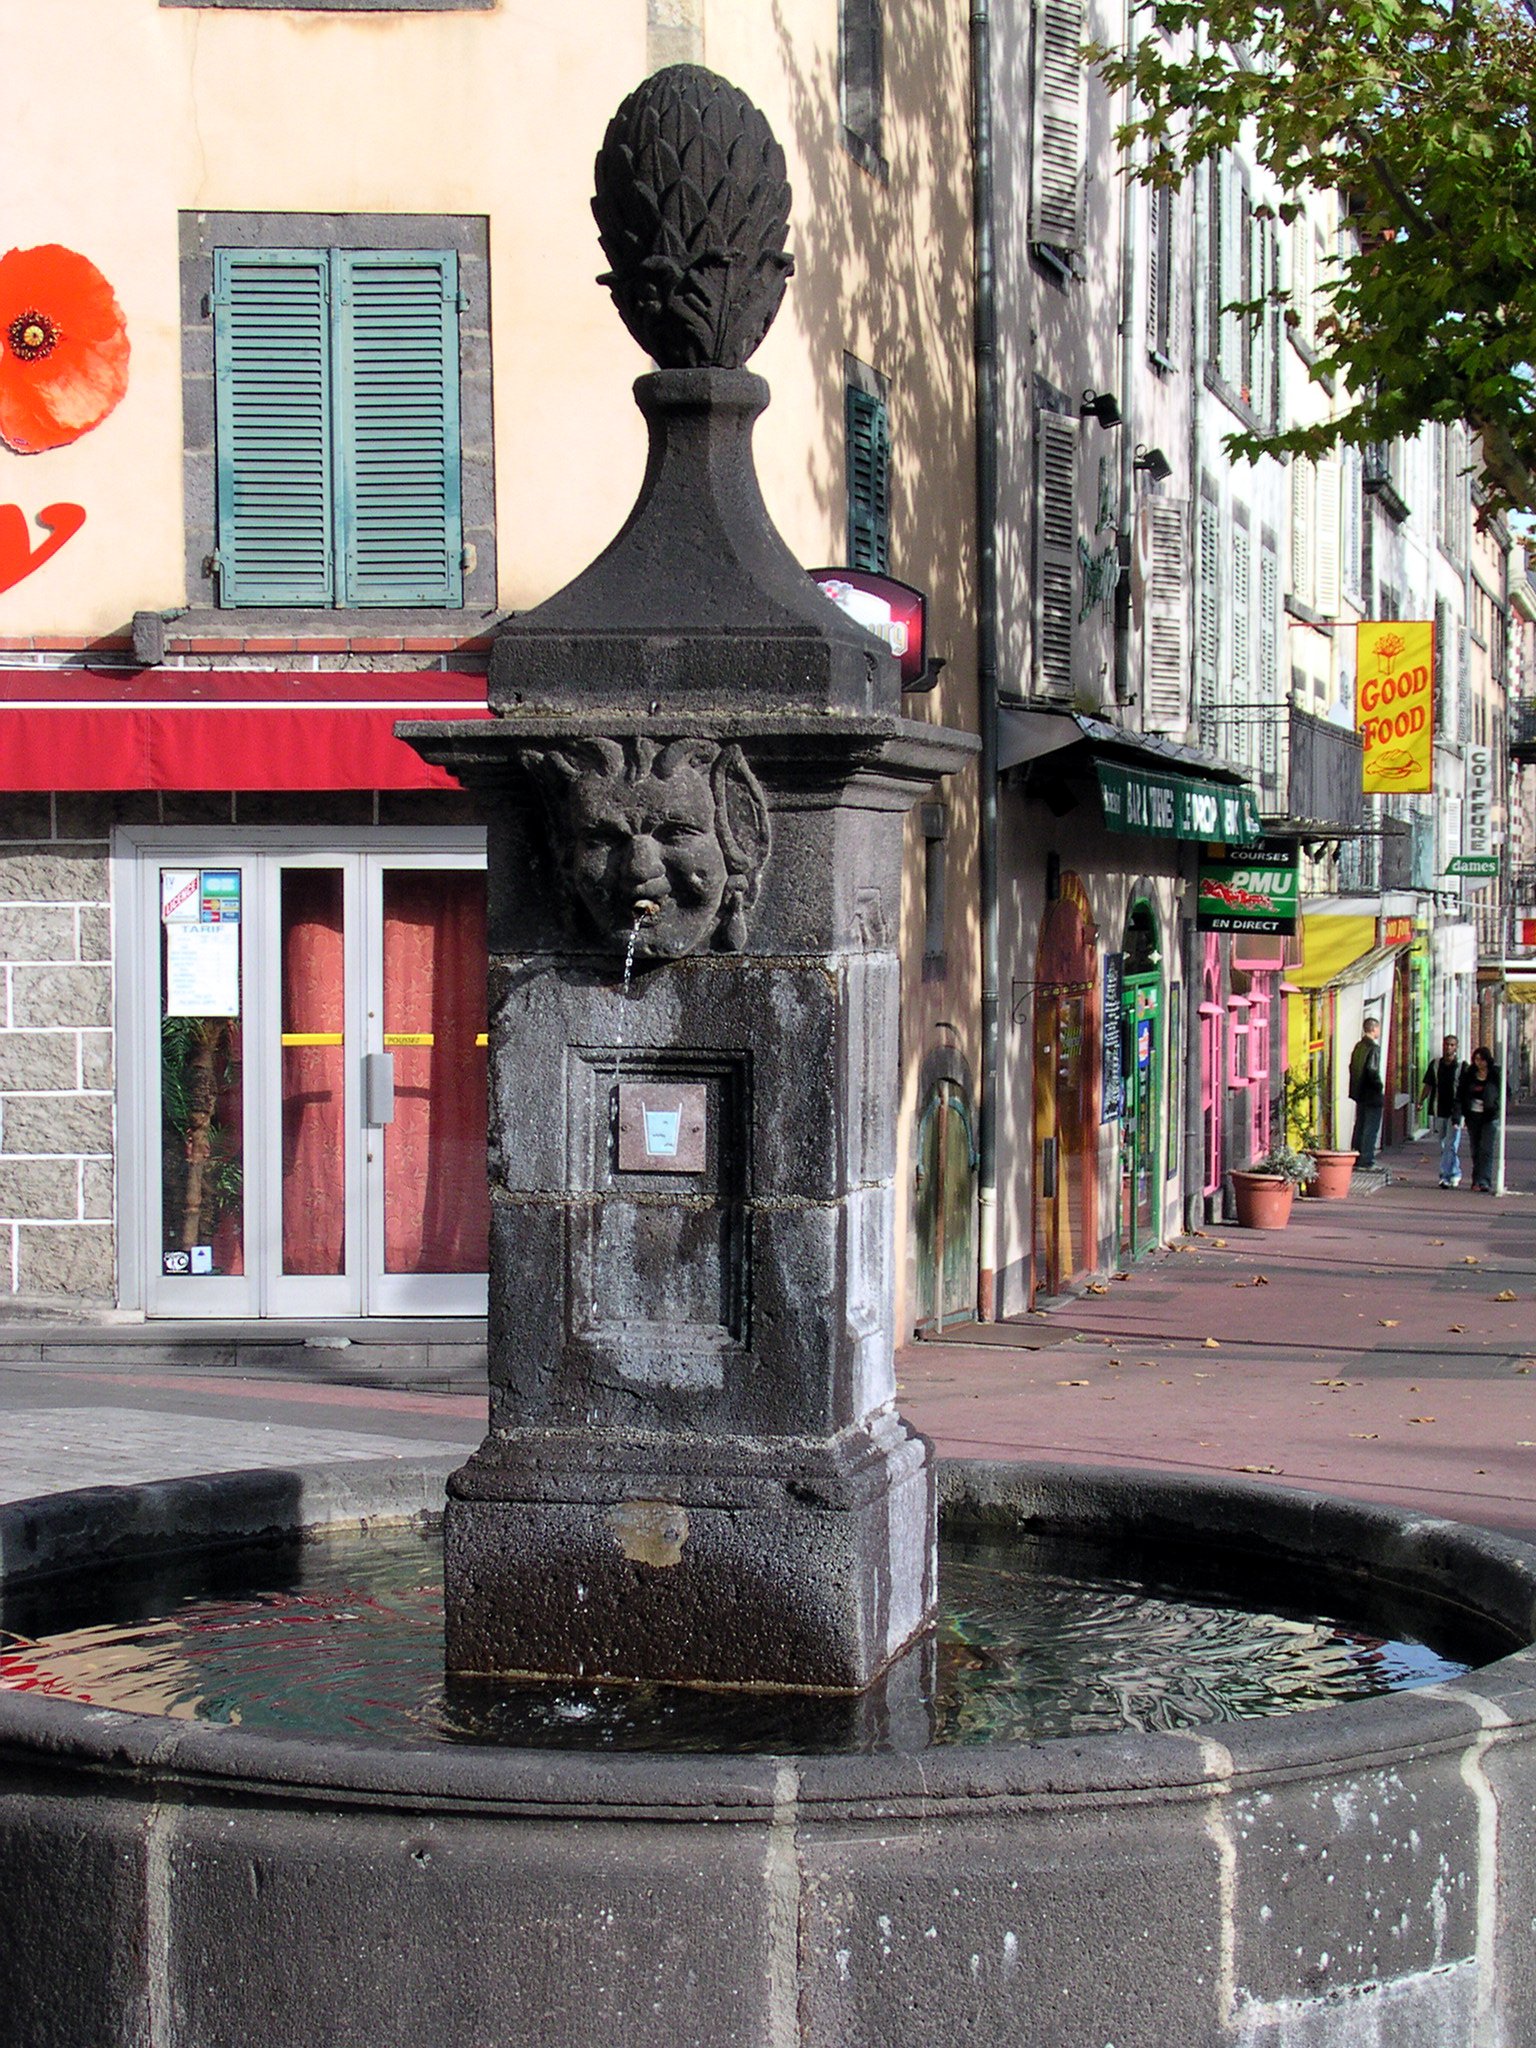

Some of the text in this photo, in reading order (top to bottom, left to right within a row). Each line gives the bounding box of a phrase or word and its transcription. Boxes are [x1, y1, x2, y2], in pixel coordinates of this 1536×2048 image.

[1361, 666, 1428, 712] GOOD
[1362, 705, 1426, 752] FOOD
[1471, 752, 1486, 851] COIFFURE
[1230, 852, 1289, 862] COURSES
[1452, 859, 1496, 872] dames
[1231, 871, 1293, 895] PMU
[182, 925, 224, 933] TARIF
[1212, 919, 1279, 931] EN DIRECT
